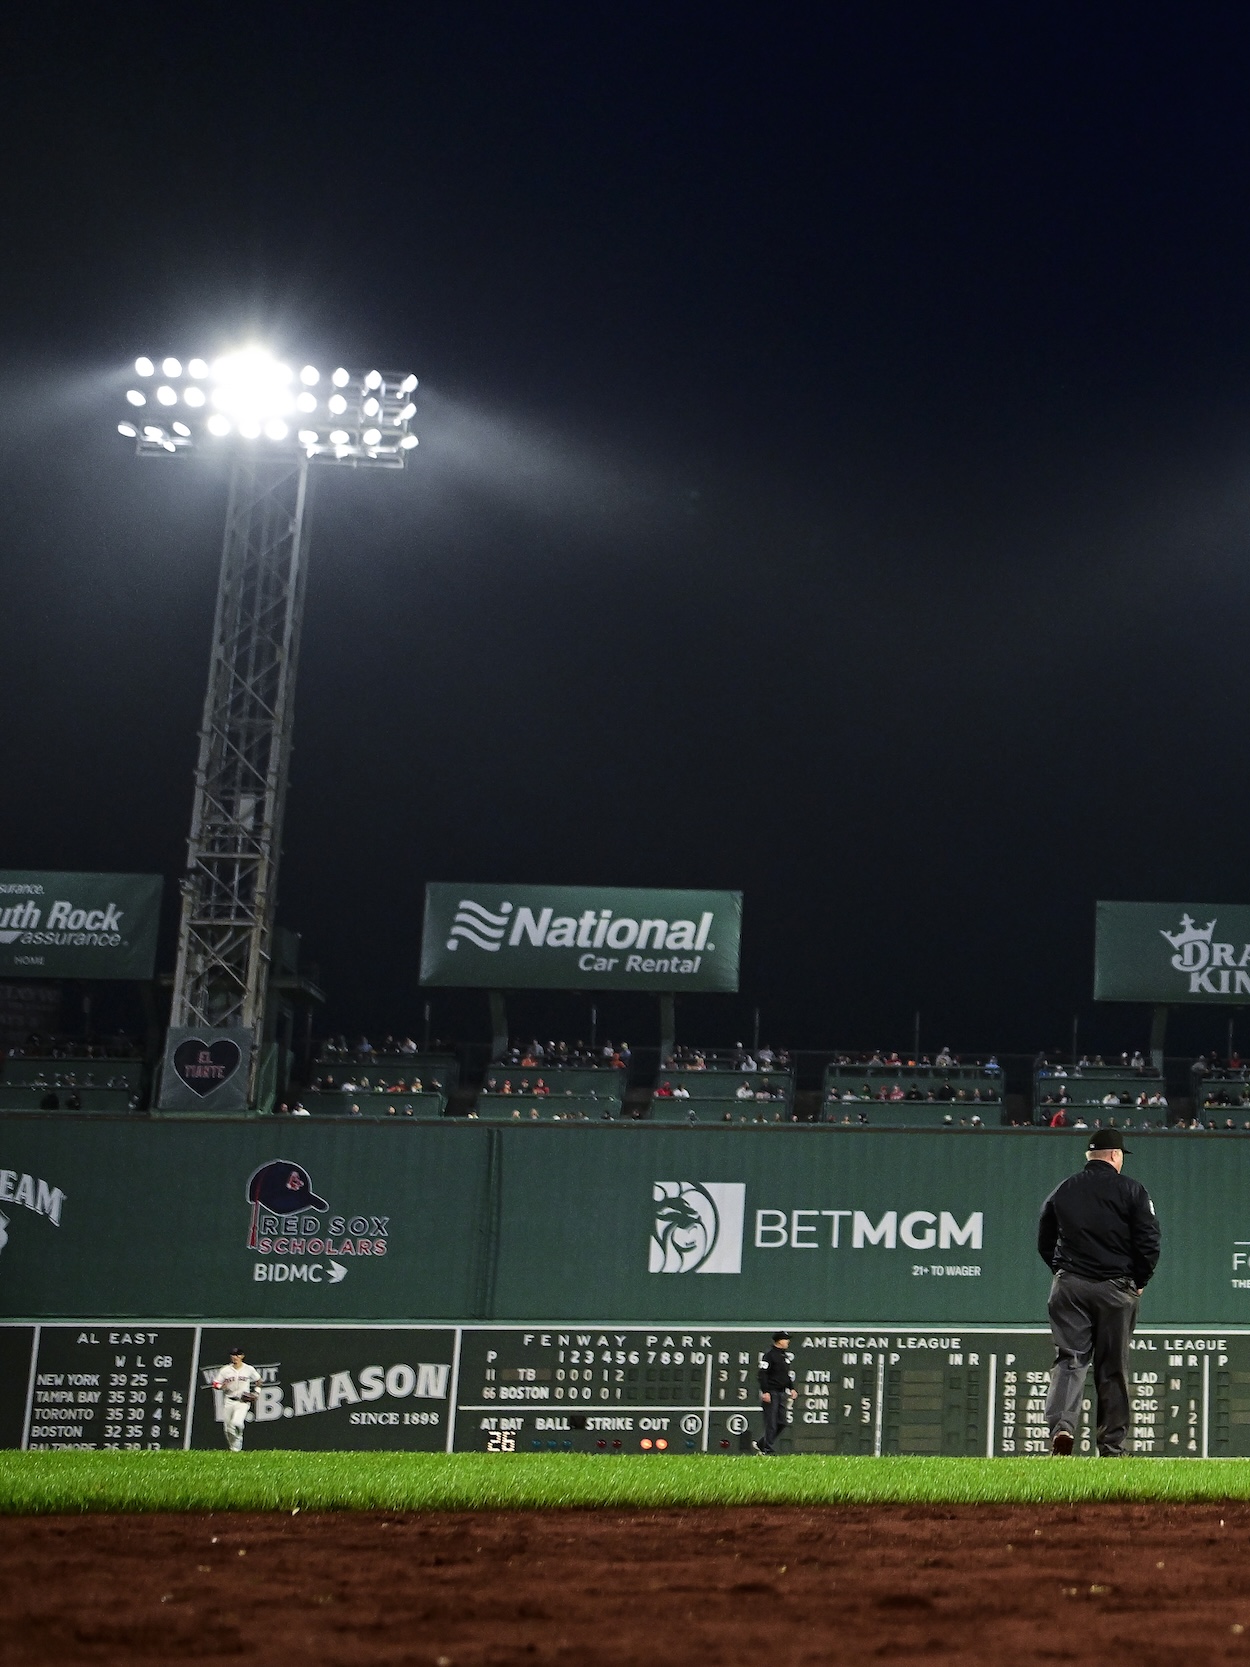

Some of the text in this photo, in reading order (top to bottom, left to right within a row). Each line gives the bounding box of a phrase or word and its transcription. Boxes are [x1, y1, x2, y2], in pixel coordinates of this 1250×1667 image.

[47, 901, 124, 931] Rock
[508, 907, 715, 951] National
[20, 931, 122, 947] assurance
[578, 953, 702, 974] Car Rental
[260, 1214, 390, 1237] RED SOX
[755, 1209, 984, 1250] BETMGM
[258, 1237, 388, 1256] SCHOLARS
[253, 1263, 324, 1283] BIDMC
[911, 1265, 982, 1277] 21+ TO WAGER
[77, 1332, 159, 1345] AL EAST
[802, 1337, 962, 1349] AMERICAN LEAGUE
[1164, 1339, 1228, 1351] LEAGUE
[114, 1355, 173, 1368] W L GB
[487, 1350, 498, 1363] P
[719, 1352, 729, 1365] R
[739, 1352, 750, 1365] H
[842, 1353, 980, 1366] IN R P IN R
[1005, 1353, 1016, 1366] P
[1168, 1354, 1183, 1367] IN
[1188, 1354, 1199, 1367] R
[1218, 1354, 1229, 1367] P
[36, 1374, 149, 1387] NEW YORK 39 25
[517, 1368, 537, 1382] TB
[805, 1370, 831, 1383] ATH
[1004, 1371, 1159, 1384] 26 SEA LAD
[500, 1386, 550, 1400] BOSTON
[804, 1384, 829, 1396] LAA
[1004, 1385, 1017, 1397] 29
[1137, 1385, 1155, 1398] SD
[36, 1391, 75, 1404] TAMPA
[77, 1391, 101, 1404] BAY
[108, 1391, 126, 1404] 35
[129, 1391, 147, 1404] 30
[153, 1390, 165, 1404] 4
[805, 1397, 829, 1410] CIN
[1131, 1399, 1159, 1412] CHC
[34, 1408, 95, 1421] TORONTO
[105, 1408, 124, 1421] 35
[127, 1408, 145, 1421] 30
[151, 1408, 163, 1421] 4
[350, 1412, 440, 1426] SINCE 1898
[803, 1411, 829, 1424] CLE
[1003, 1412, 1016, 1425] 32
[1133, 1412, 1156, 1425] PHI
[480, 1418, 499, 1430] AT
[500, 1418, 525, 1431] BAT
[535, 1418, 571, 1431] BALL
[585, 1418, 634, 1431] STRIKE
[639, 1418, 671, 1431] OUT
[31, 1425, 83, 1438] BOSTON
[104, 1425, 122, 1438] 32
[125, 1425, 144, 1438] 35
[1025, 1426, 1050, 1439] TOR
[1133, 1426, 1156, 1439] MIA
[487, 1431, 517, 1453] 26
[1024, 1440, 1050, 1452] STL
[1133, 1440, 1156, 1452] PIT
